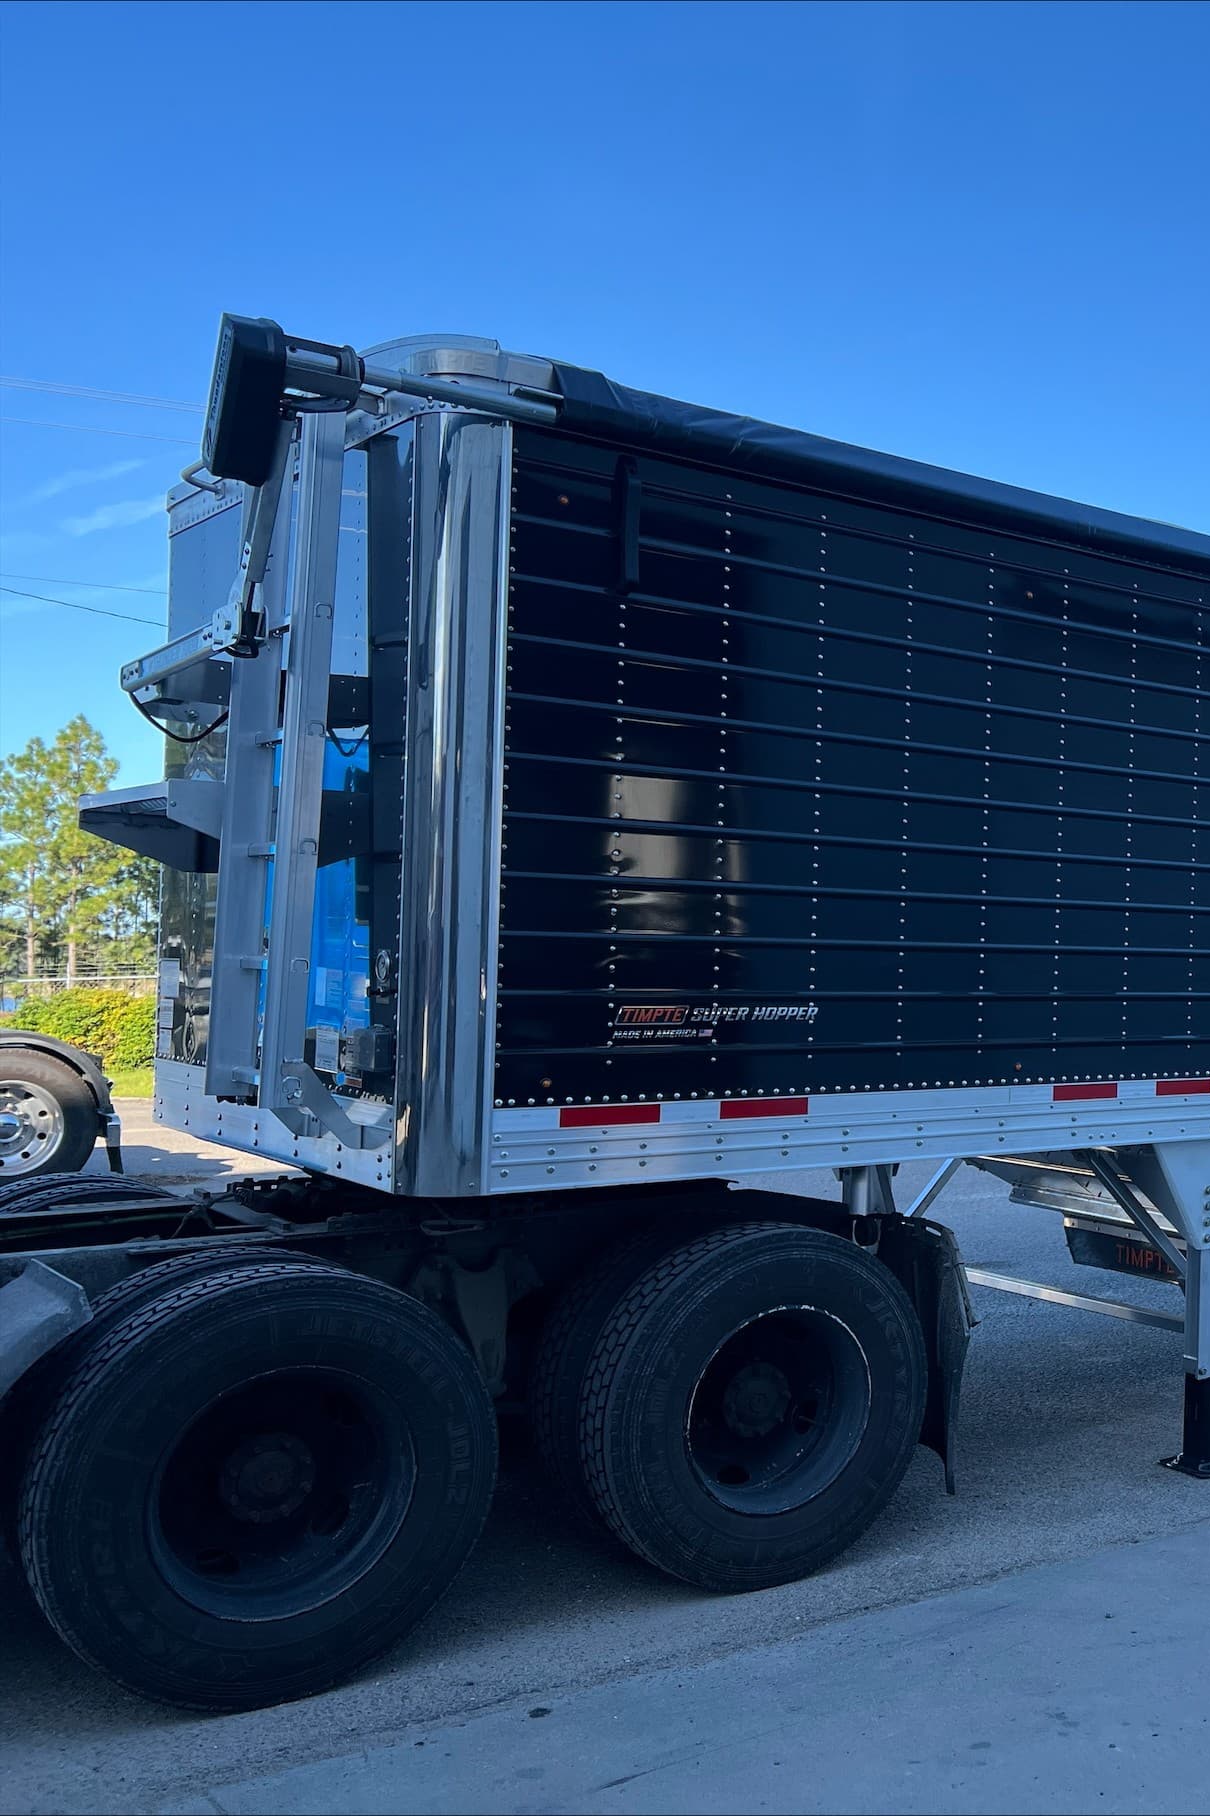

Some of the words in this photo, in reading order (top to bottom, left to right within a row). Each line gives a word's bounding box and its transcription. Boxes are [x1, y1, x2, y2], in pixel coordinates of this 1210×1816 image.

[622, 1008, 685, 1023] TIMPTE
[690, 1007, 749, 1022] SUPER
[752, 1006, 818, 1021] HOPPER
[612, 1030, 640, 1039] MADE
[642, 1030, 654, 1038] IN
[654, 1029, 697, 1038] AMERICA
